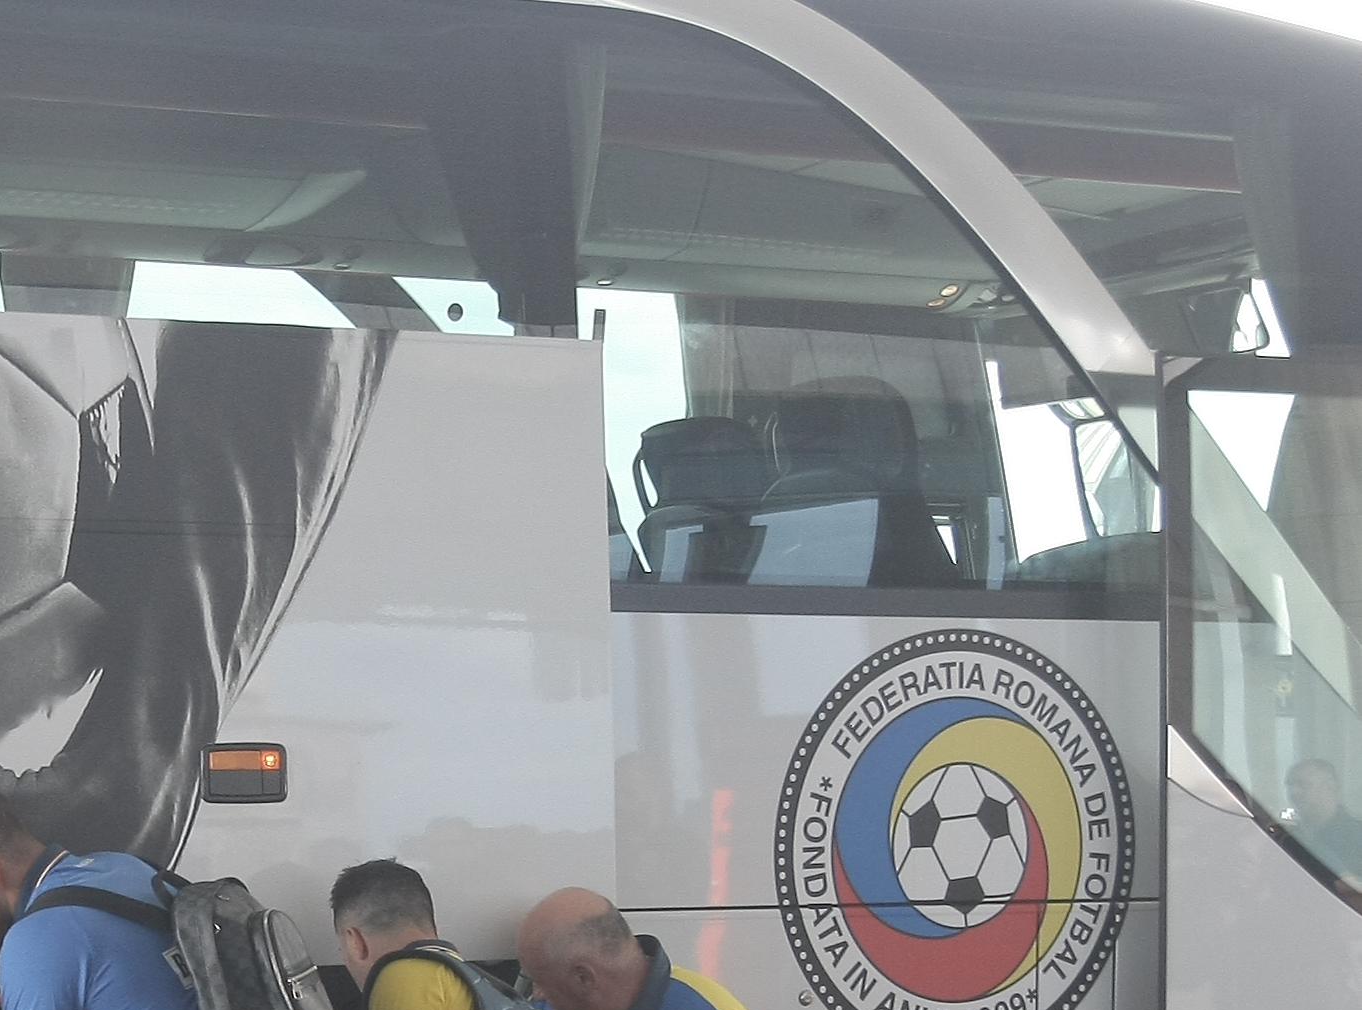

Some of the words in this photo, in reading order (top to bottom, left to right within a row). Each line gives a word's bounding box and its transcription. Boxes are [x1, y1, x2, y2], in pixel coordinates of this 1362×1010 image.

[830, 660, 986, 760] FEDERATIA
[991, 671, 1097, 789] ROMANA
[1084, 791, 1111, 841] DE
[801, 792, 850, 968] FONDATA
[841, 962, 878, 1002] IN
[1041, 852, 1110, 982] FOTBAL
